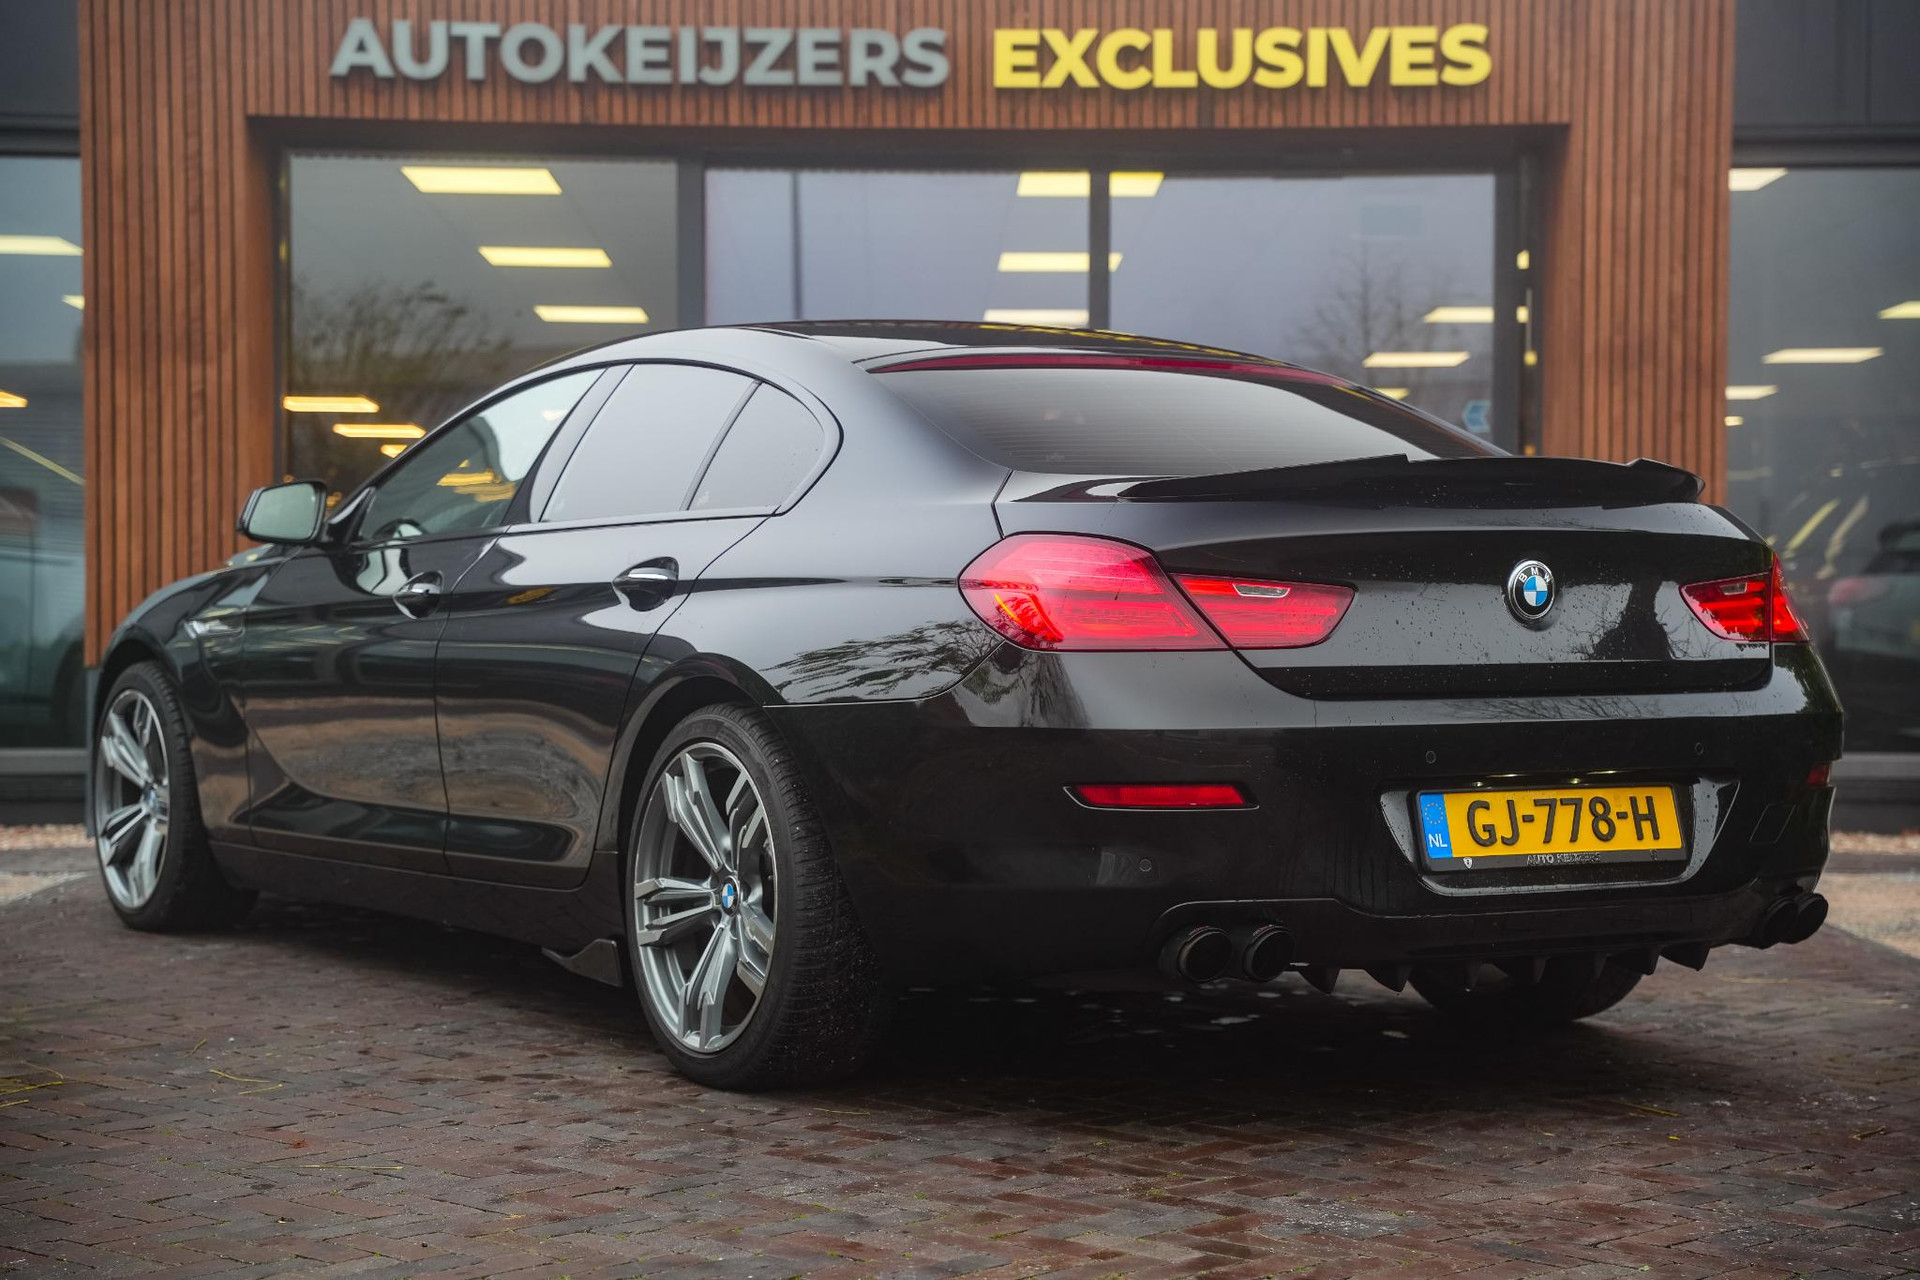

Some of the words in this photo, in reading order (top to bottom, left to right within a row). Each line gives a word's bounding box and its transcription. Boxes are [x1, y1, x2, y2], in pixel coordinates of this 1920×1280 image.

[329, 17, 950, 87] AUTOKEIJZERS
[993, 22, 1493, 90] EXCLUSIVES
[1518, 566, 1552, 584] BMW
[1466, 795, 1661, 847] GJ-778-H
[1428, 833, 1448, 848] NL
